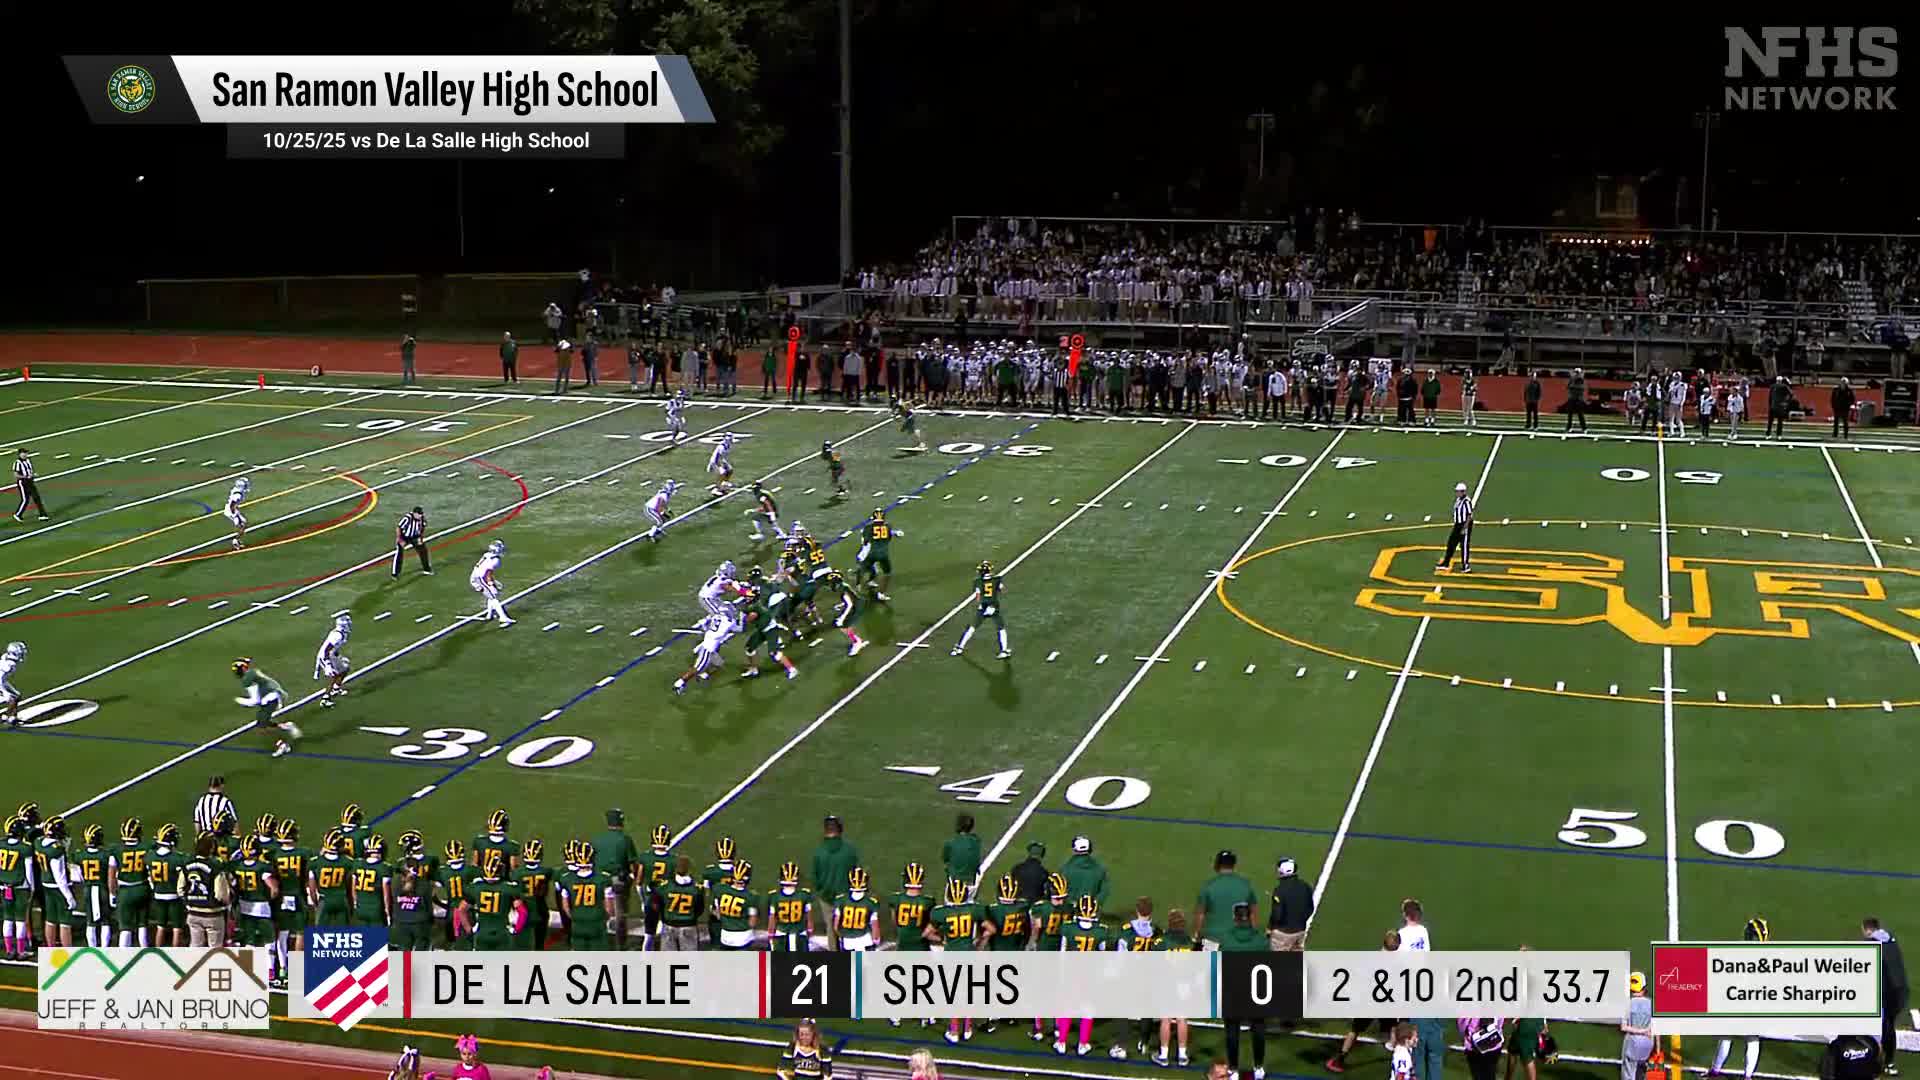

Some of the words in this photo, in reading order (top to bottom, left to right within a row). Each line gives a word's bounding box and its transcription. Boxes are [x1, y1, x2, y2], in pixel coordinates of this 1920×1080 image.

[983, 582, 993, 598] 5
[82, 859, 101, 881] 12
[120, 851, 146, 873] 56
[151, 861, 169, 883] 21
[651, 861, 667, 883] 2
[319, 867, 345, 888] 60
[479, 891, 500, 914] 51
[572, 883, 597, 907] 78
[667, 892, 694, 914] 72
[777, 900, 803, 923] 28
[842, 904, 868, 930] 80
[897, 902, 924, 927] 64
[946, 913, 972, 939] 30
